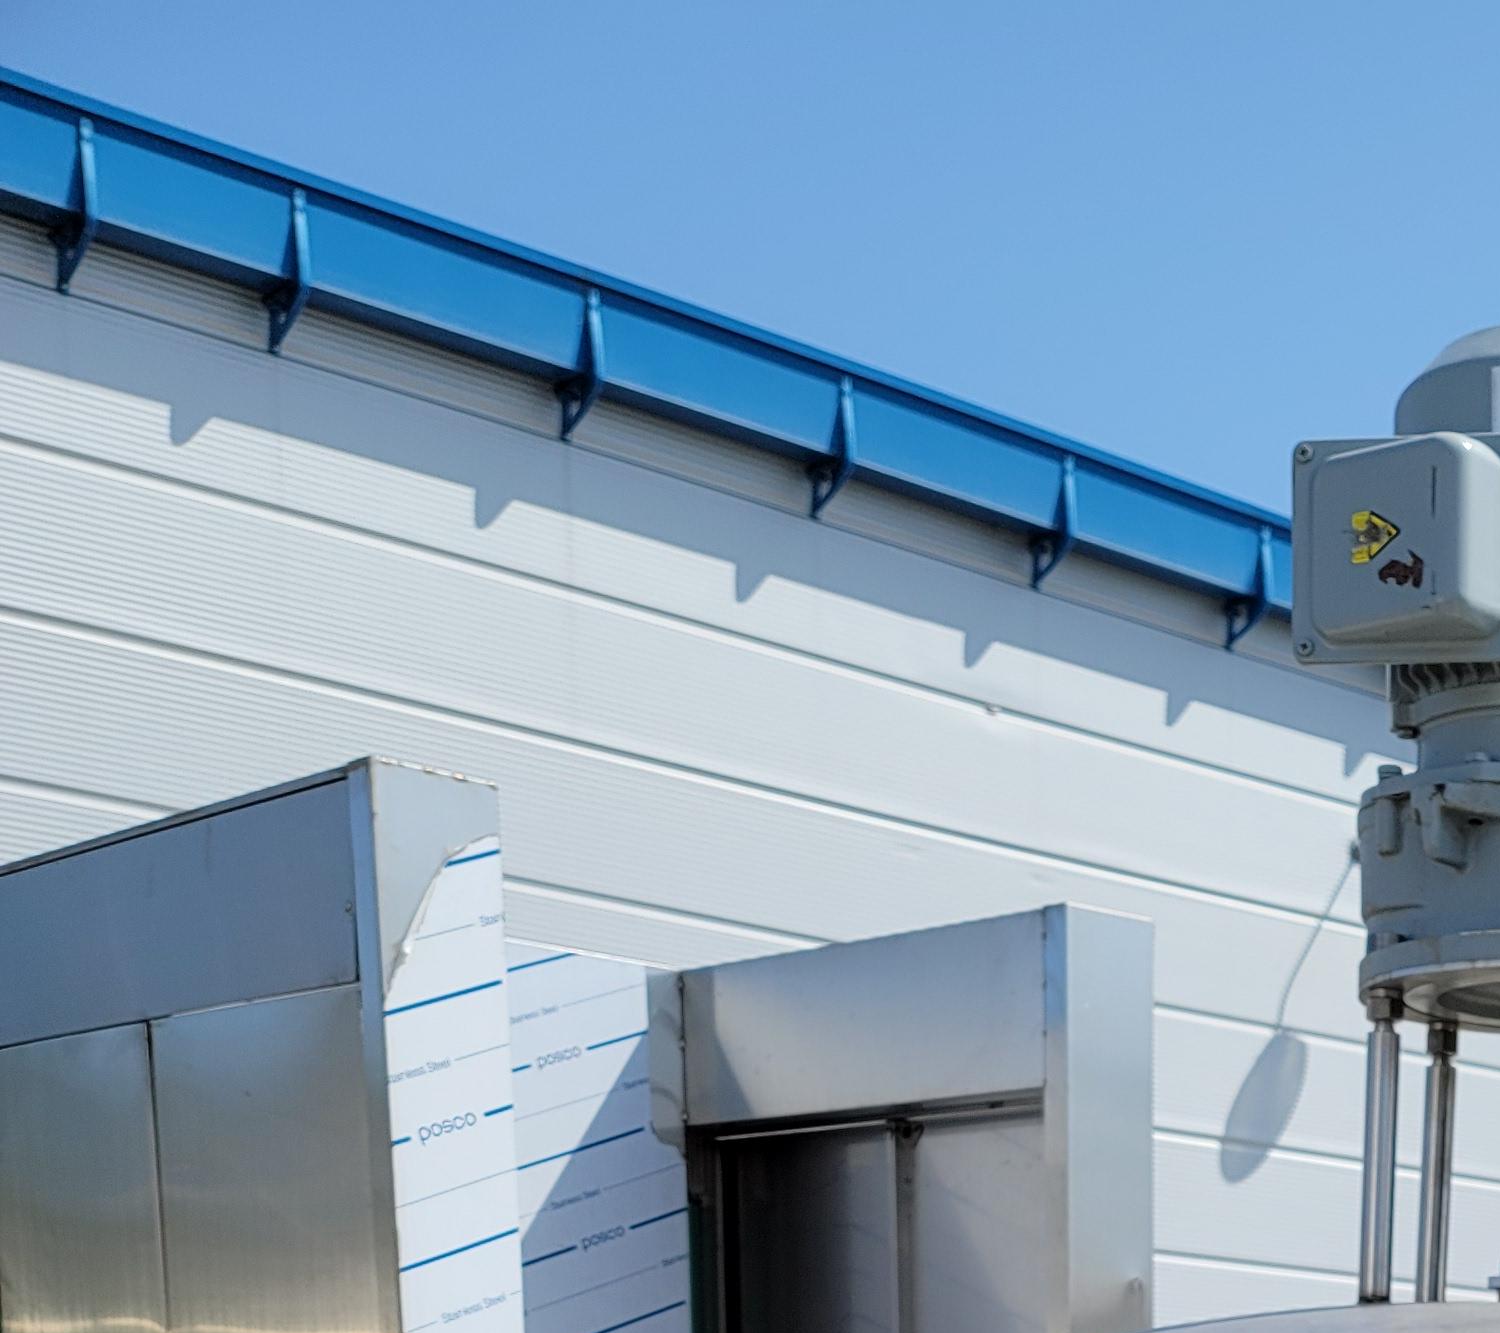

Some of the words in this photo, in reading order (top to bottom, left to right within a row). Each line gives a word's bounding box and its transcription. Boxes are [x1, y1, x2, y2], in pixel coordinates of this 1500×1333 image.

[536, 1045, 582, 1070] posco
[418, 1112, 477, 1147] posco
[582, 1225, 625, 1251] posco
